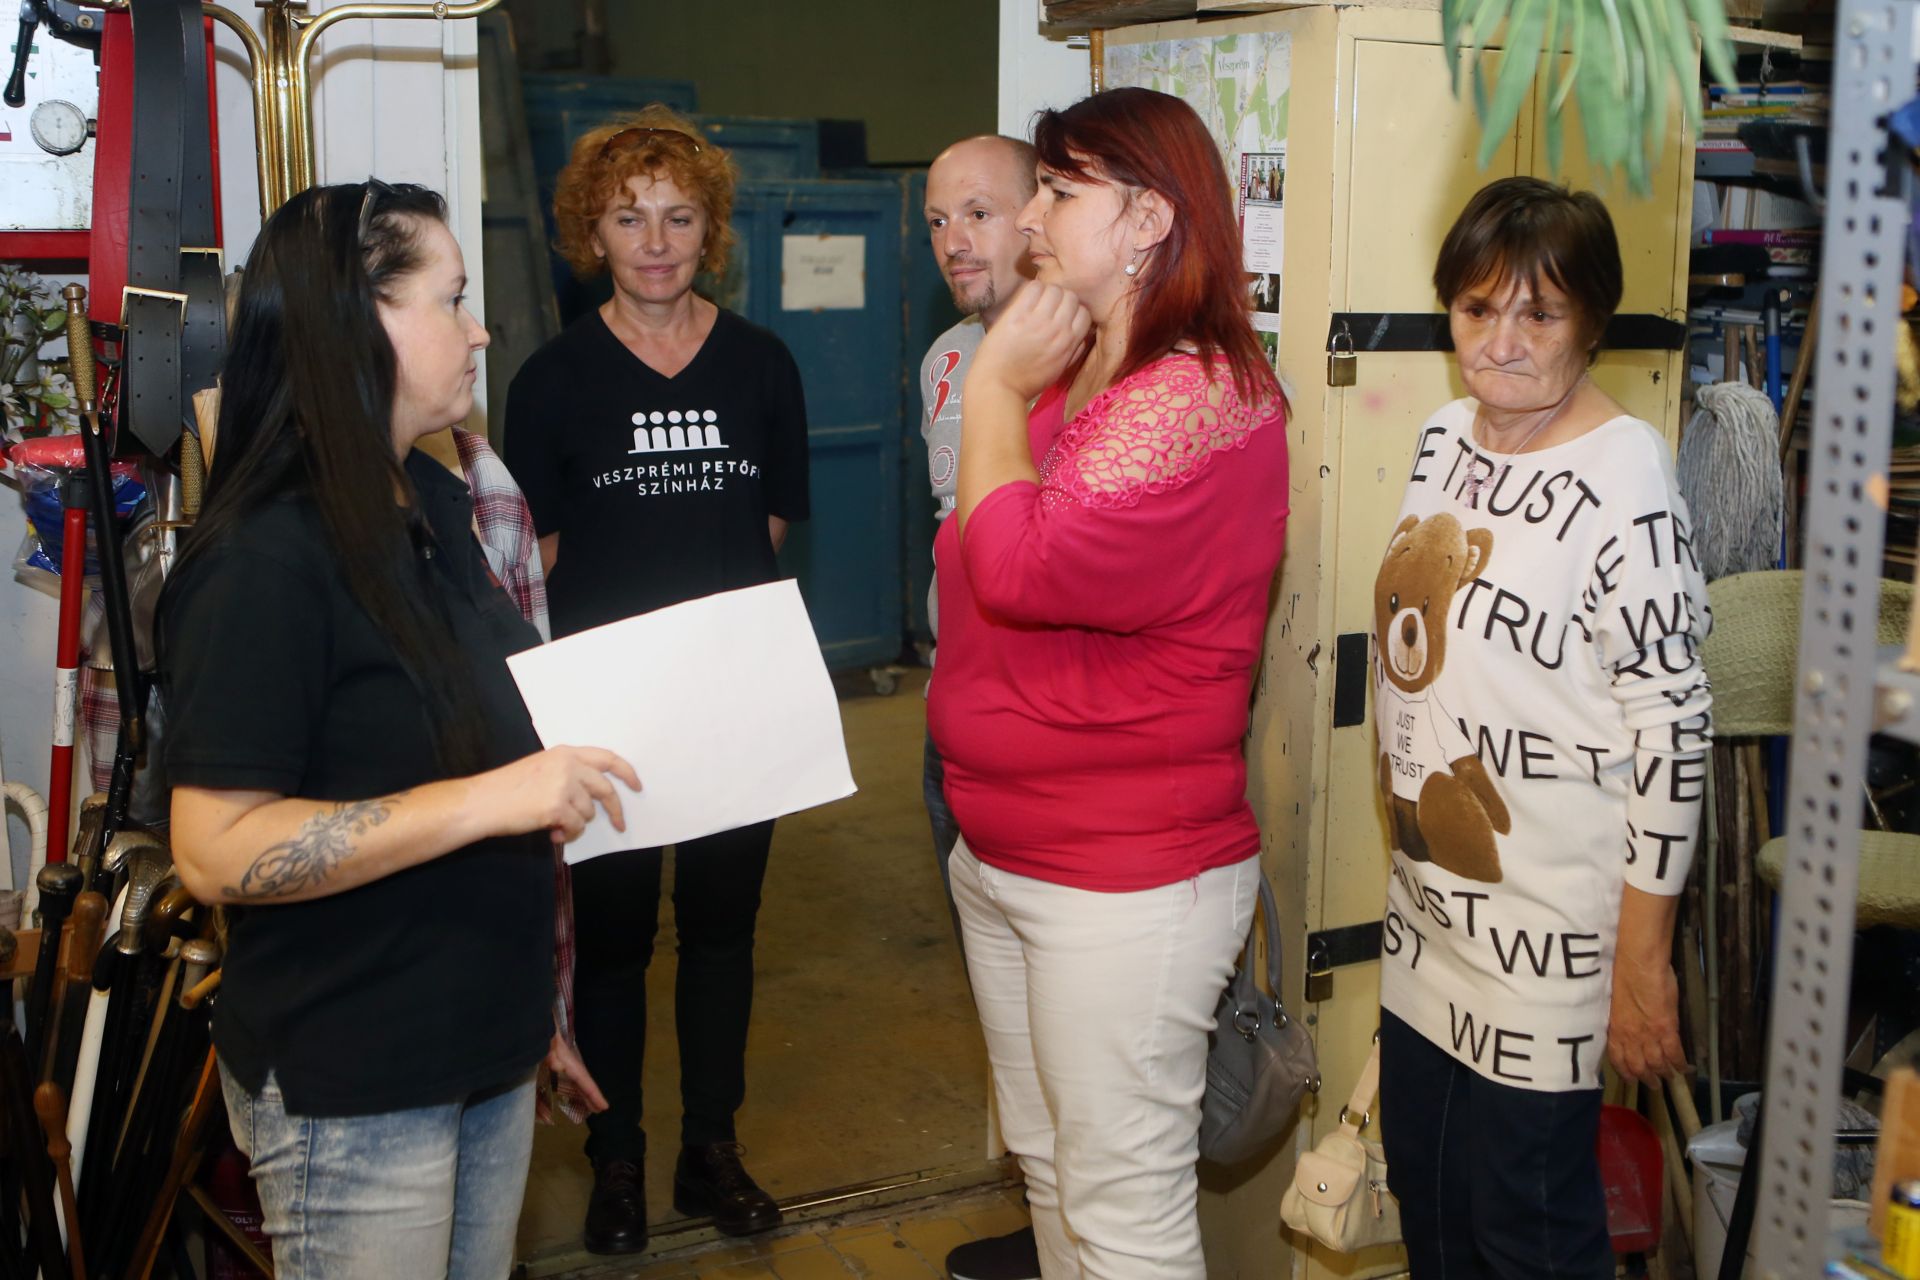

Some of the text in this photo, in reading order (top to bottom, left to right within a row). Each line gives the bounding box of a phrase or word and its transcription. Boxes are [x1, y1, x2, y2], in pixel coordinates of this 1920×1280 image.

[592, 462, 693, 489] VESZPRÉMI
[638, 475, 724, 496] SZÍNHÁZ
[1410, 427, 1602, 542] E TRUST
[1396, 710, 1415, 732] JUST
[1397, 732, 1412, 754] WE
[1458, 717, 1559, 780] WE
[1391, 753, 1425, 779] TRUST
[1393, 860, 1601, 979] UST WE
[1450, 1002, 1535, 1082] WE
